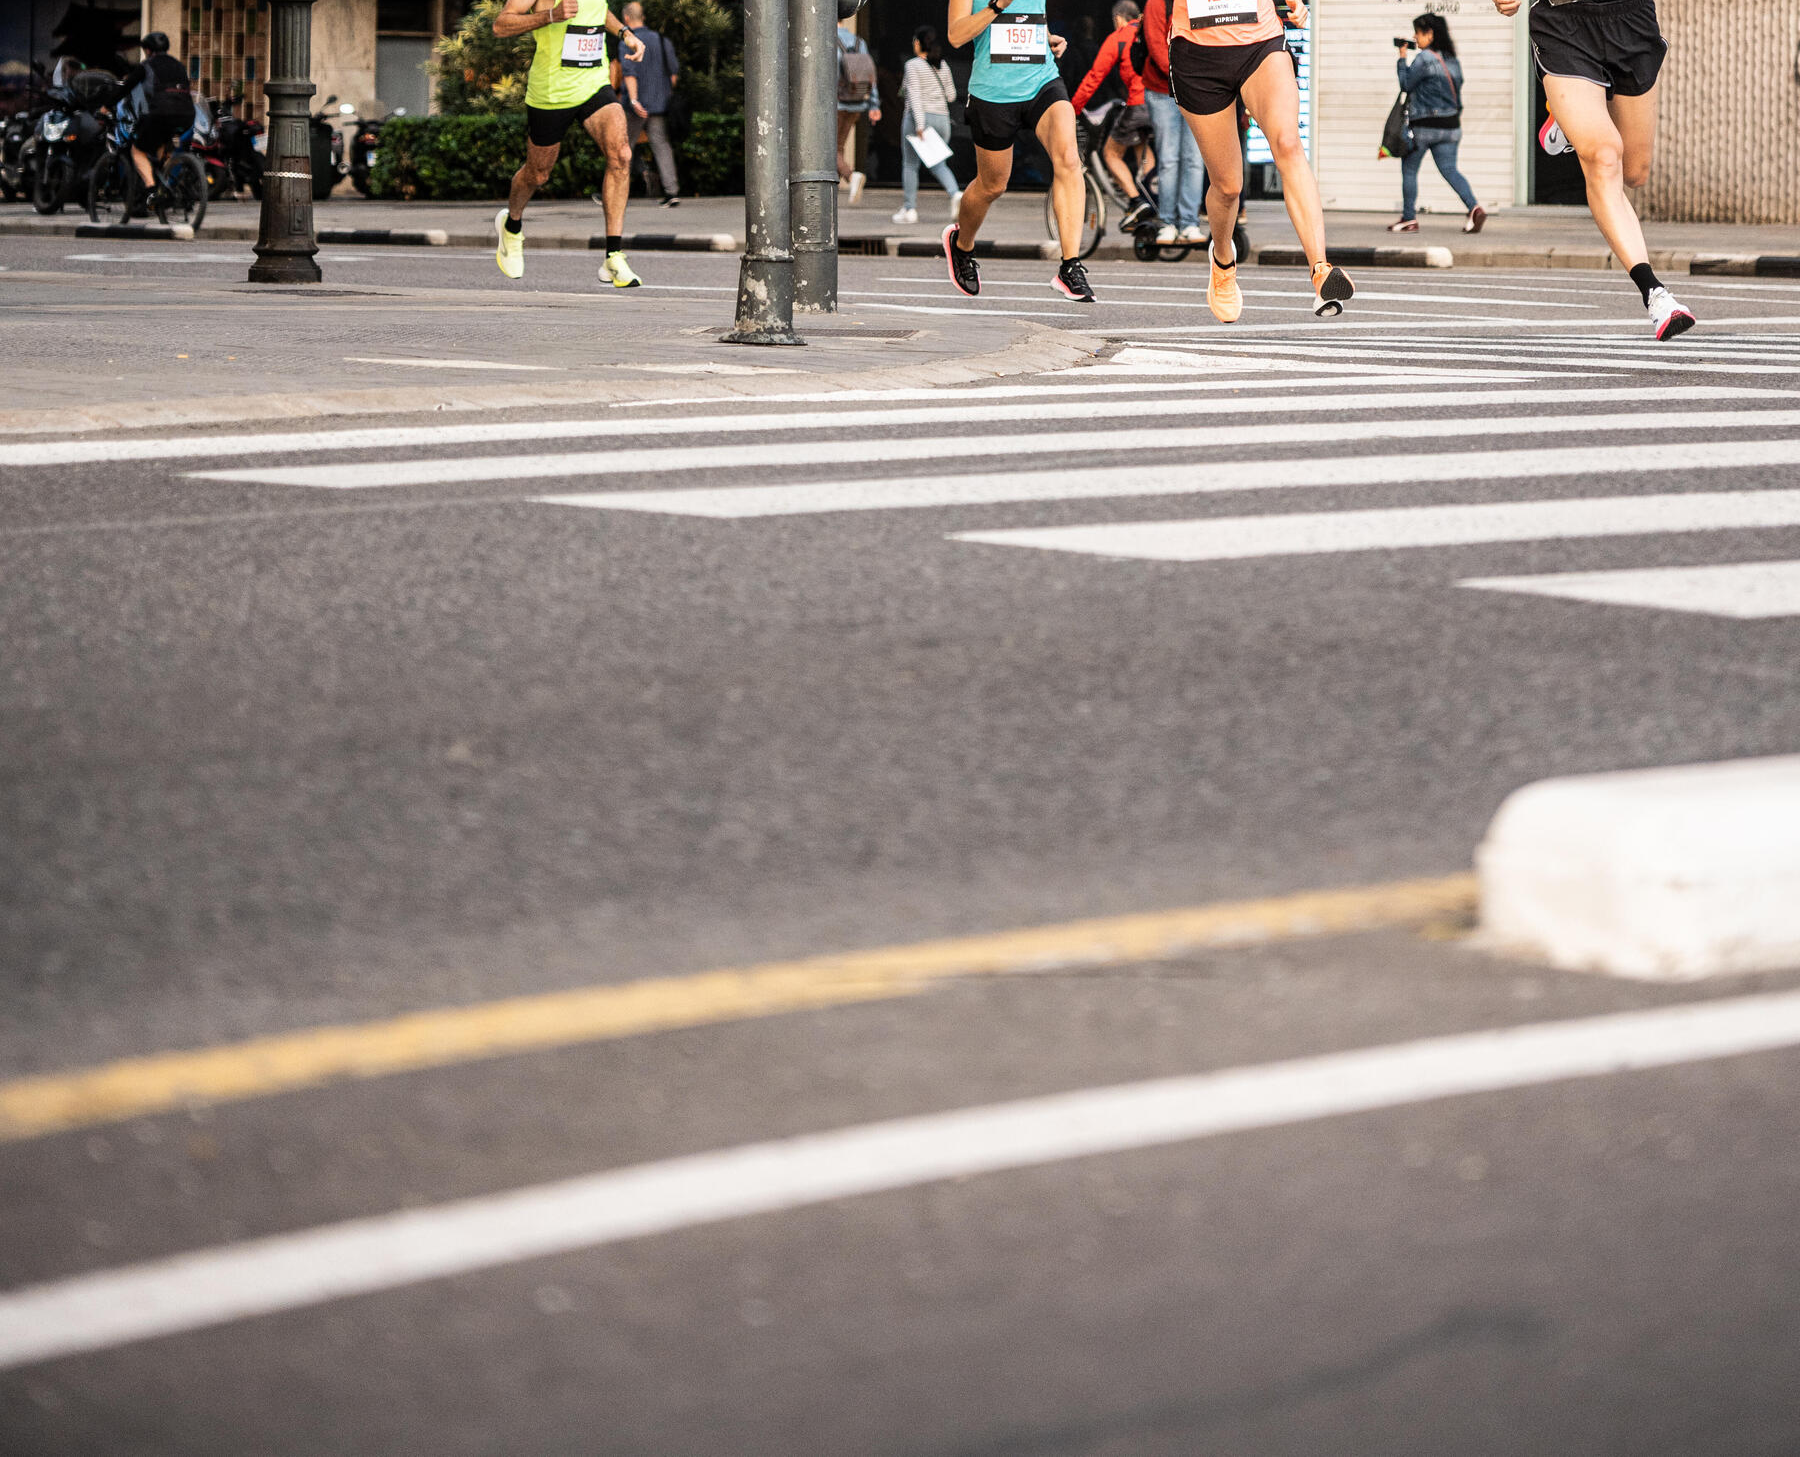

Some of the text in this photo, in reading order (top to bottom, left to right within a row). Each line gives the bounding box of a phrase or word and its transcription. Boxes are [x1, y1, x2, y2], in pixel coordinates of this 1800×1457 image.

[1214, 15, 1239, 23] KIPRUN
[1006, 28, 1033, 44] 1597
[577, 38, 598, 52] 1392
